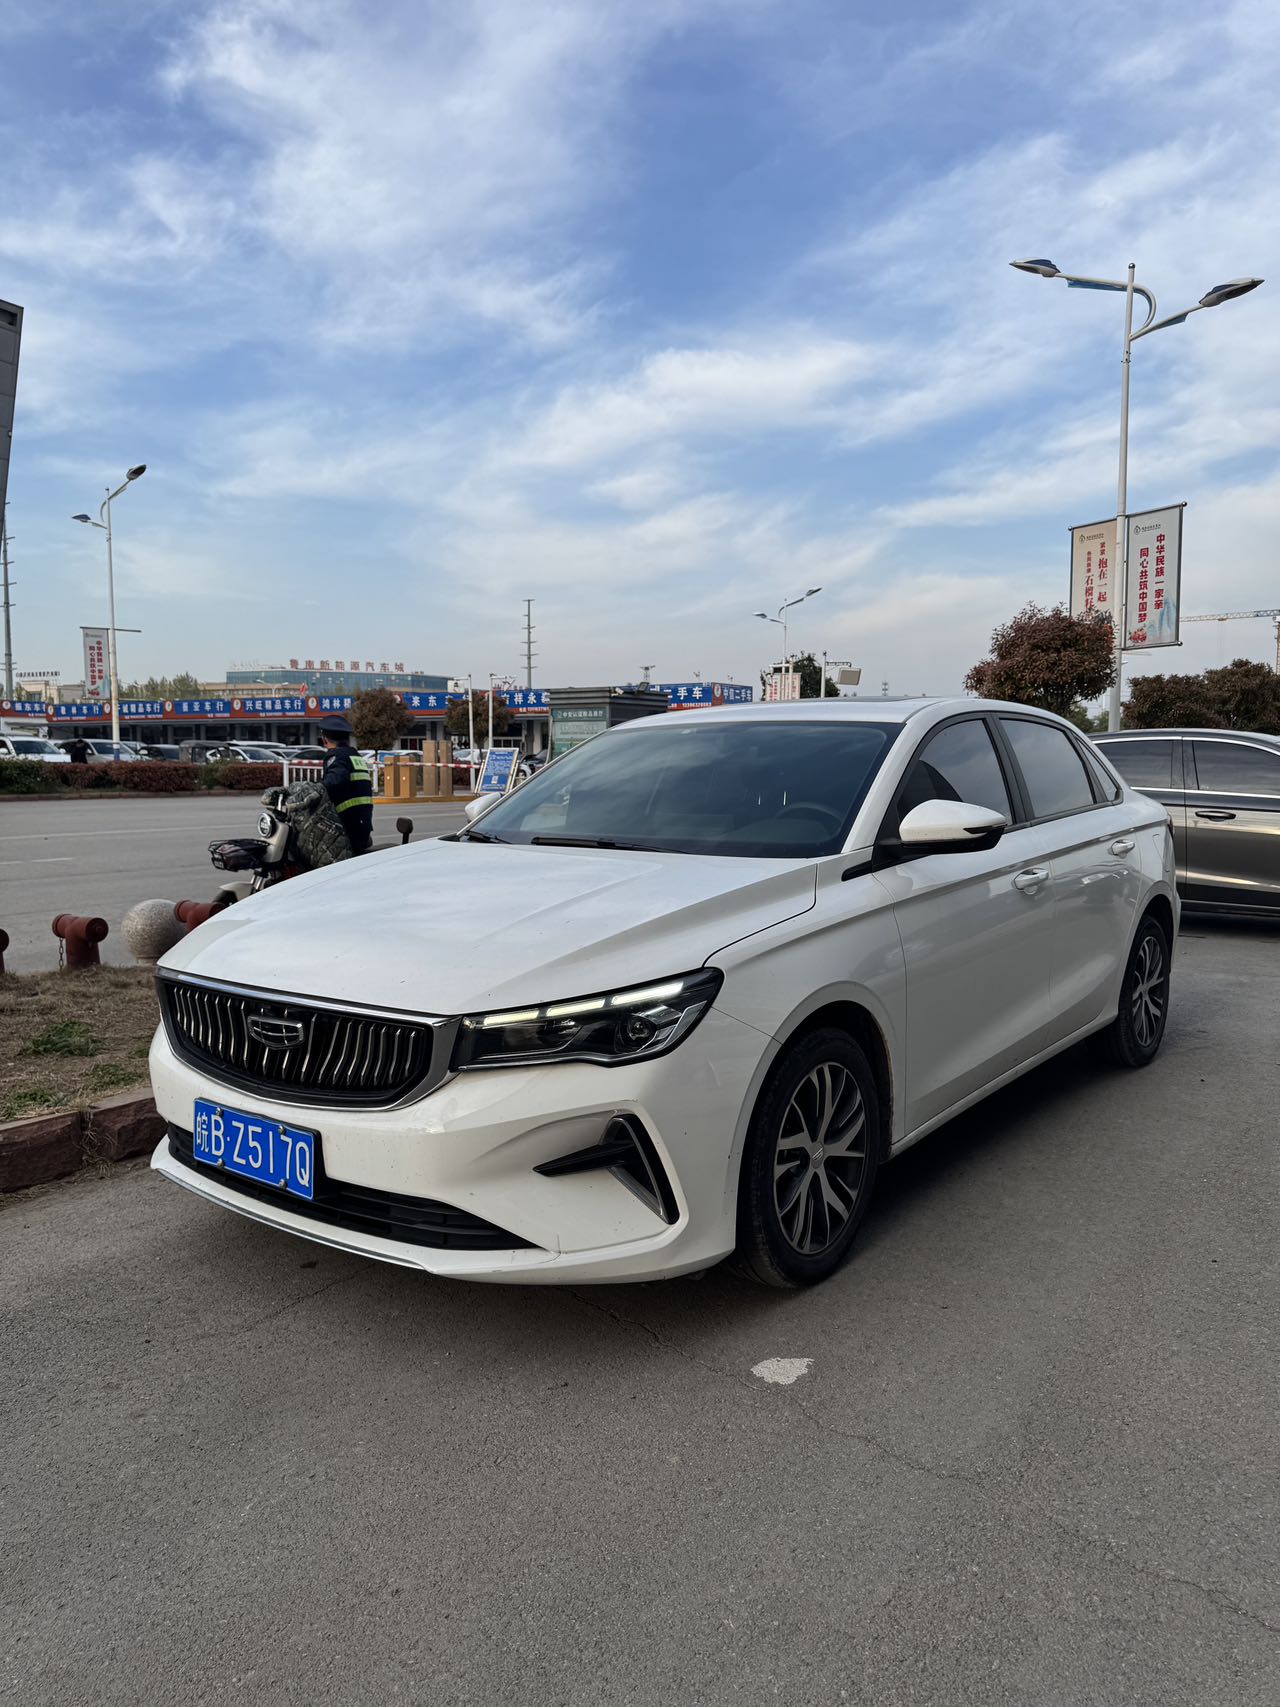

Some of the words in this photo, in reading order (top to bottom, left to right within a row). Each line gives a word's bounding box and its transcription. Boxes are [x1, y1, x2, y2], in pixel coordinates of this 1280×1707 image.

[1138, 547, 1150, 624] 同心共筑中国梦
[1154, 533, 1166, 610] 中华民族一家亲
[245, 699, 302, 711] 兴旺精品车行
